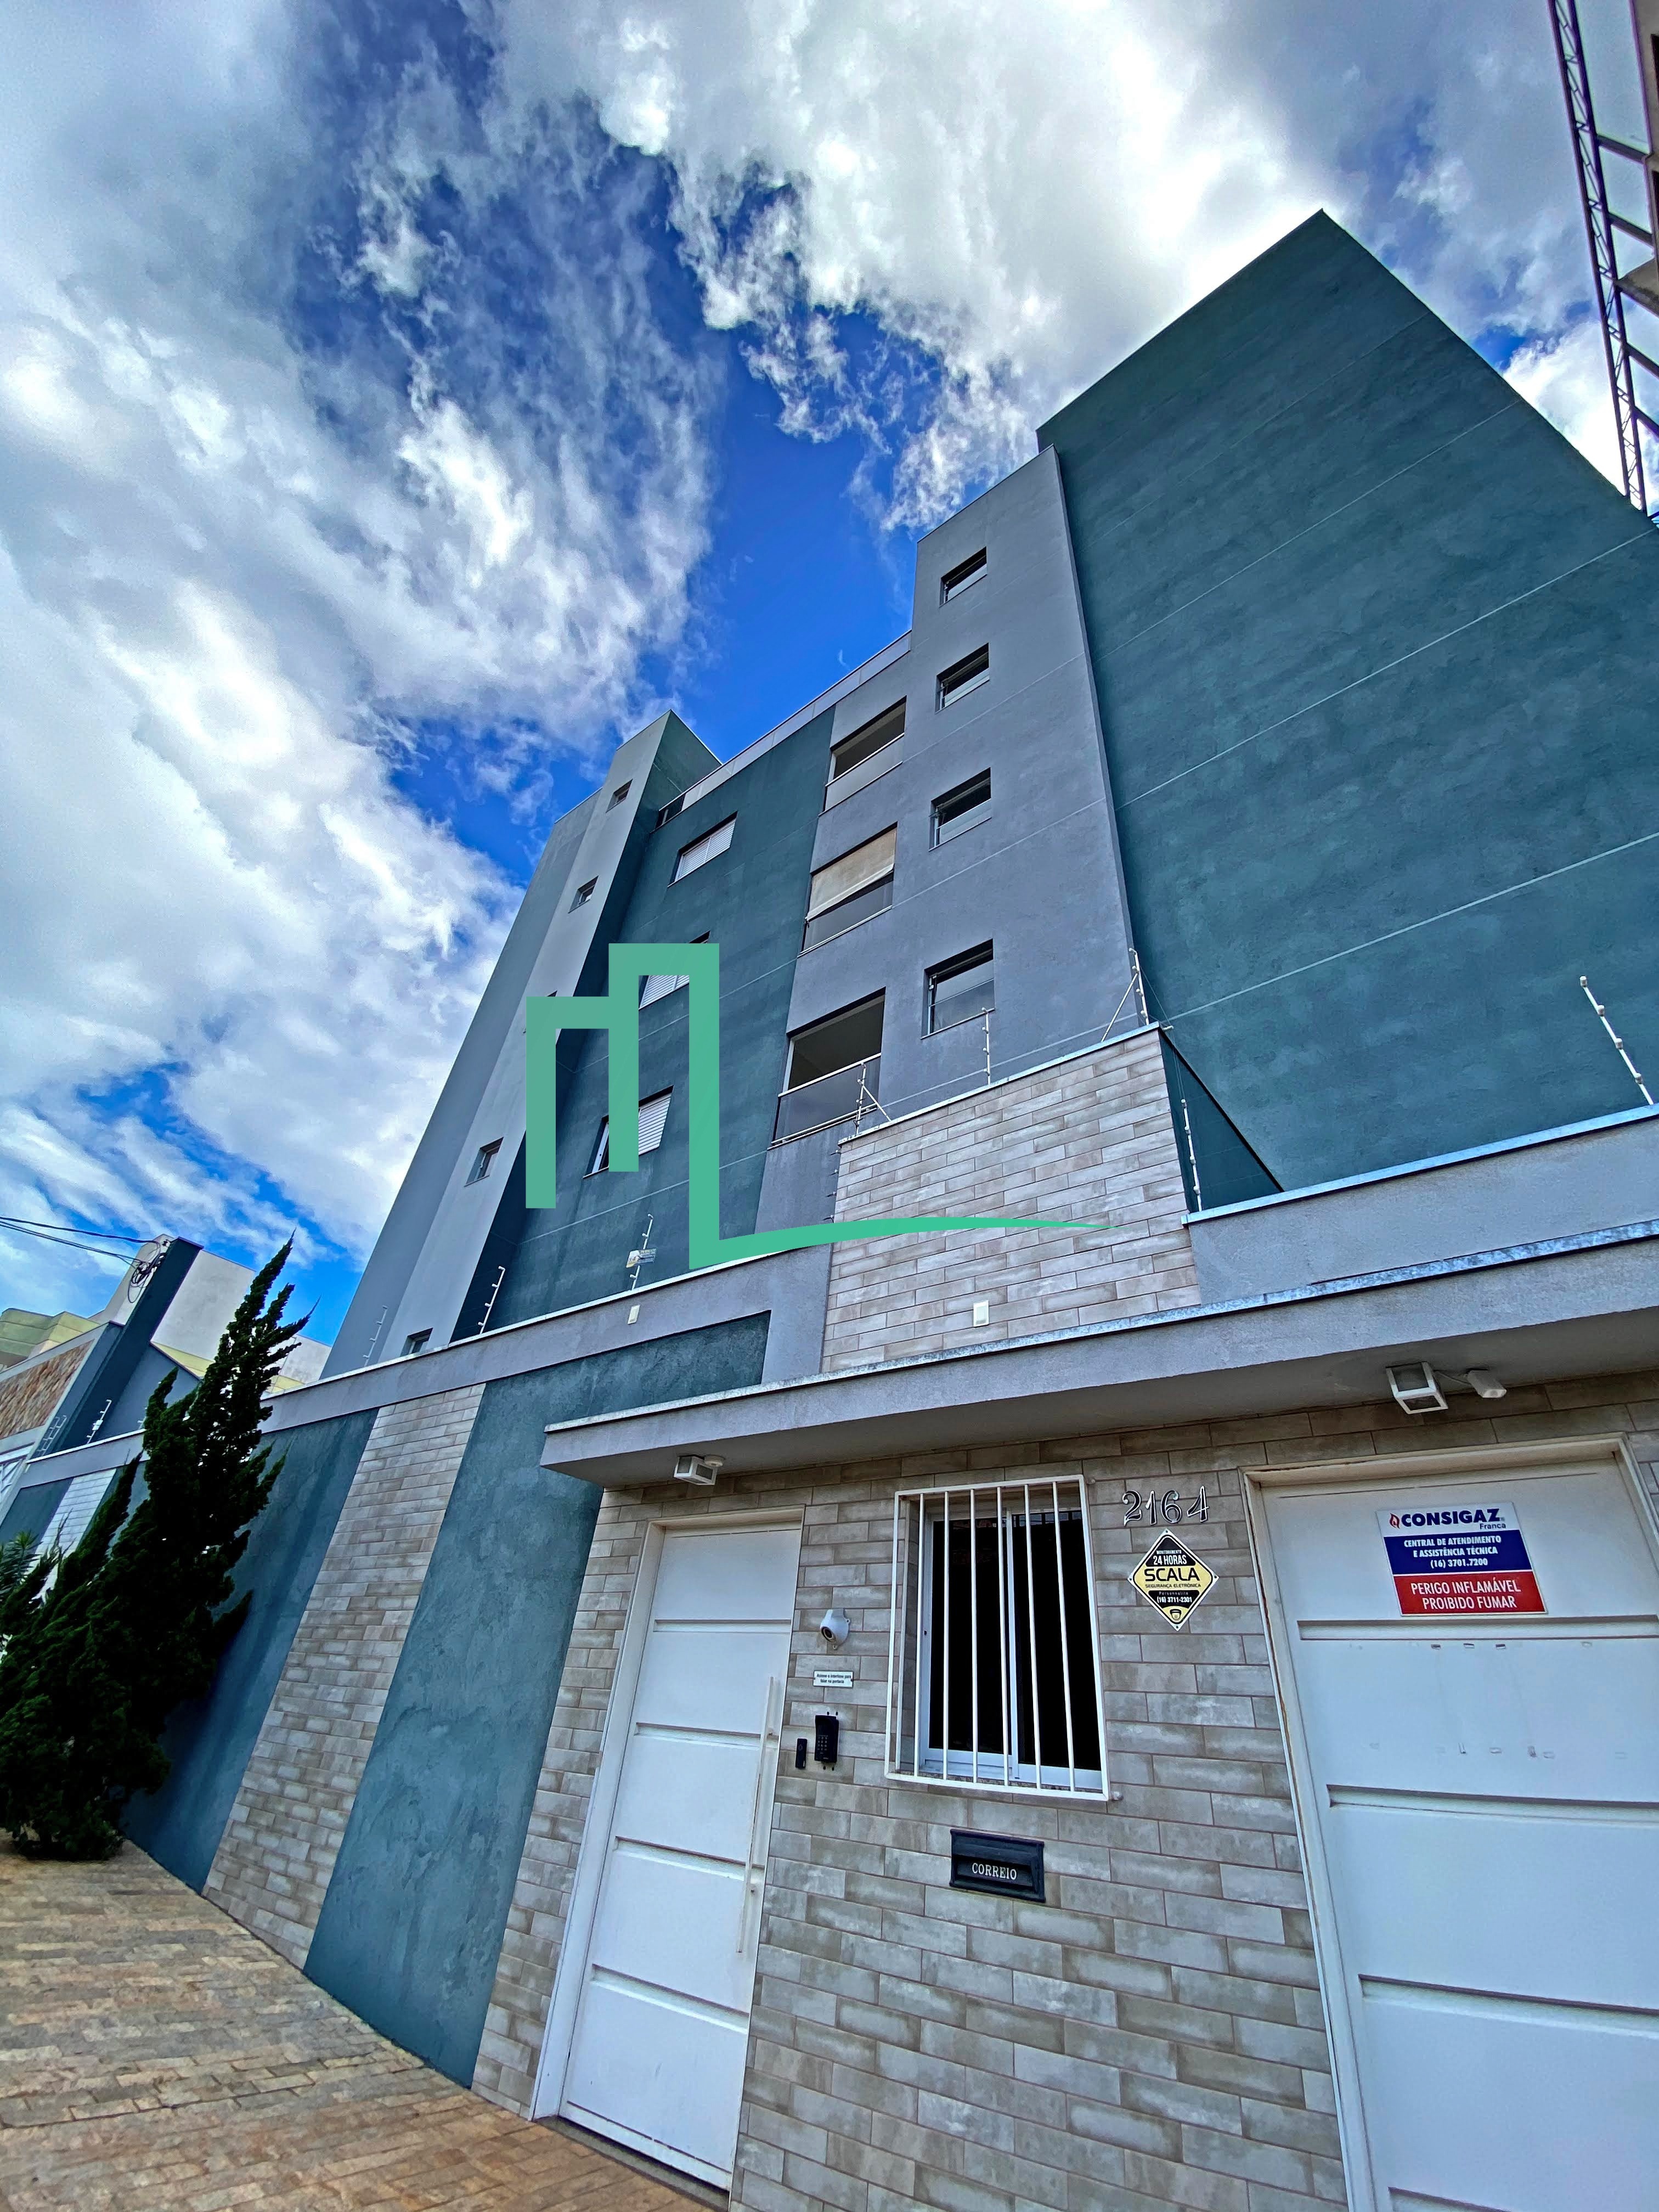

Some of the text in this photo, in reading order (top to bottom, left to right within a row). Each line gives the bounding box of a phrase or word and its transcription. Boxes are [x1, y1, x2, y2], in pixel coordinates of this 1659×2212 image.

[1122, 1485, 1209, 1527] 2164
[1401, 1509, 1500, 1527] CONSIGAZ
[1404, 1535, 1502, 1547] CENTRAL DE ATENDIMENTO
[1419, 1547, 1465, 1557] ASSISTÊNCIA
[1466, 1546, 1498, 1555] TÉCNICA
[1153, 1555, 1187, 1565] 24 HORAS
[1430, 1558, 1488, 1569] (16) 3701.7200
[1144, 1567, 1200, 1581] SCALA
[1410, 1577, 1521, 1595] PERIGO INFLAMÁVEL
[1423, 1596, 1517, 1609] PROIBIDO FUMAR
[972, 1862, 1017, 1880] CORREIO
